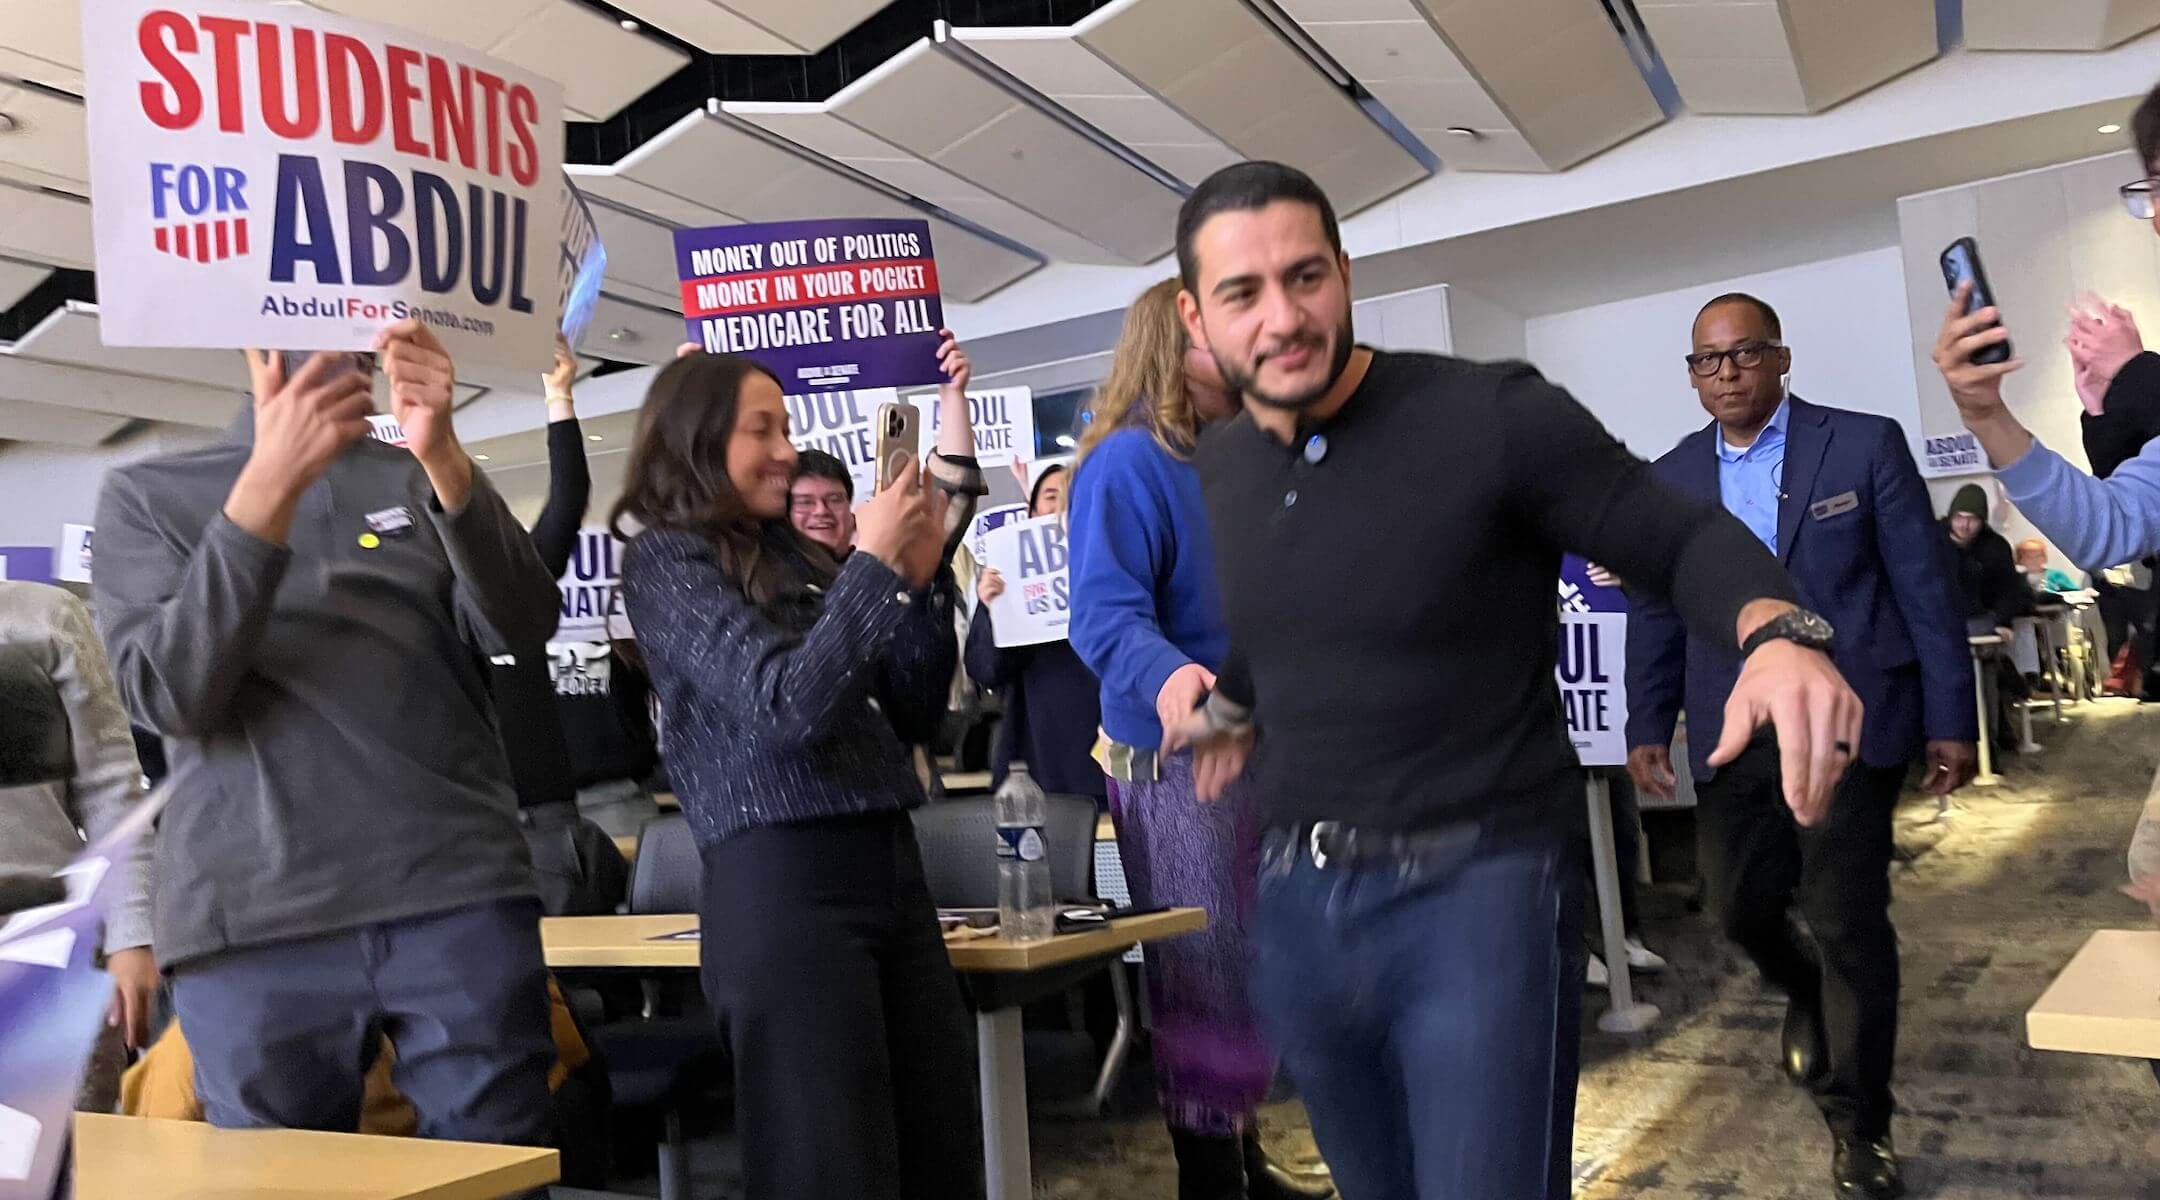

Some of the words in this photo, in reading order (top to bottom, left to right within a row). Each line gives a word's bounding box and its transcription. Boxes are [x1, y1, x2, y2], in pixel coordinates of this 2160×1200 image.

[138, 10, 539, 188] STUDENTS
[150, 162, 250, 219] FOR
[269, 153, 534, 314] ABDUL
[691, 243, 763, 276] MONEY
[770, 239, 808, 268] OUT
[814, 236, 837, 263] OF
[842, 233, 921, 261] POLITICS
[696, 278, 768, 310] MONEY
[774, 275, 797, 301] IN
[802, 271, 856, 299] YOUR
[860, 265, 925, 294] POCKET
[701, 307, 834, 355] MEDICARE
[839, 302, 888, 341] FOR
[895, 298, 935, 335] ALL
